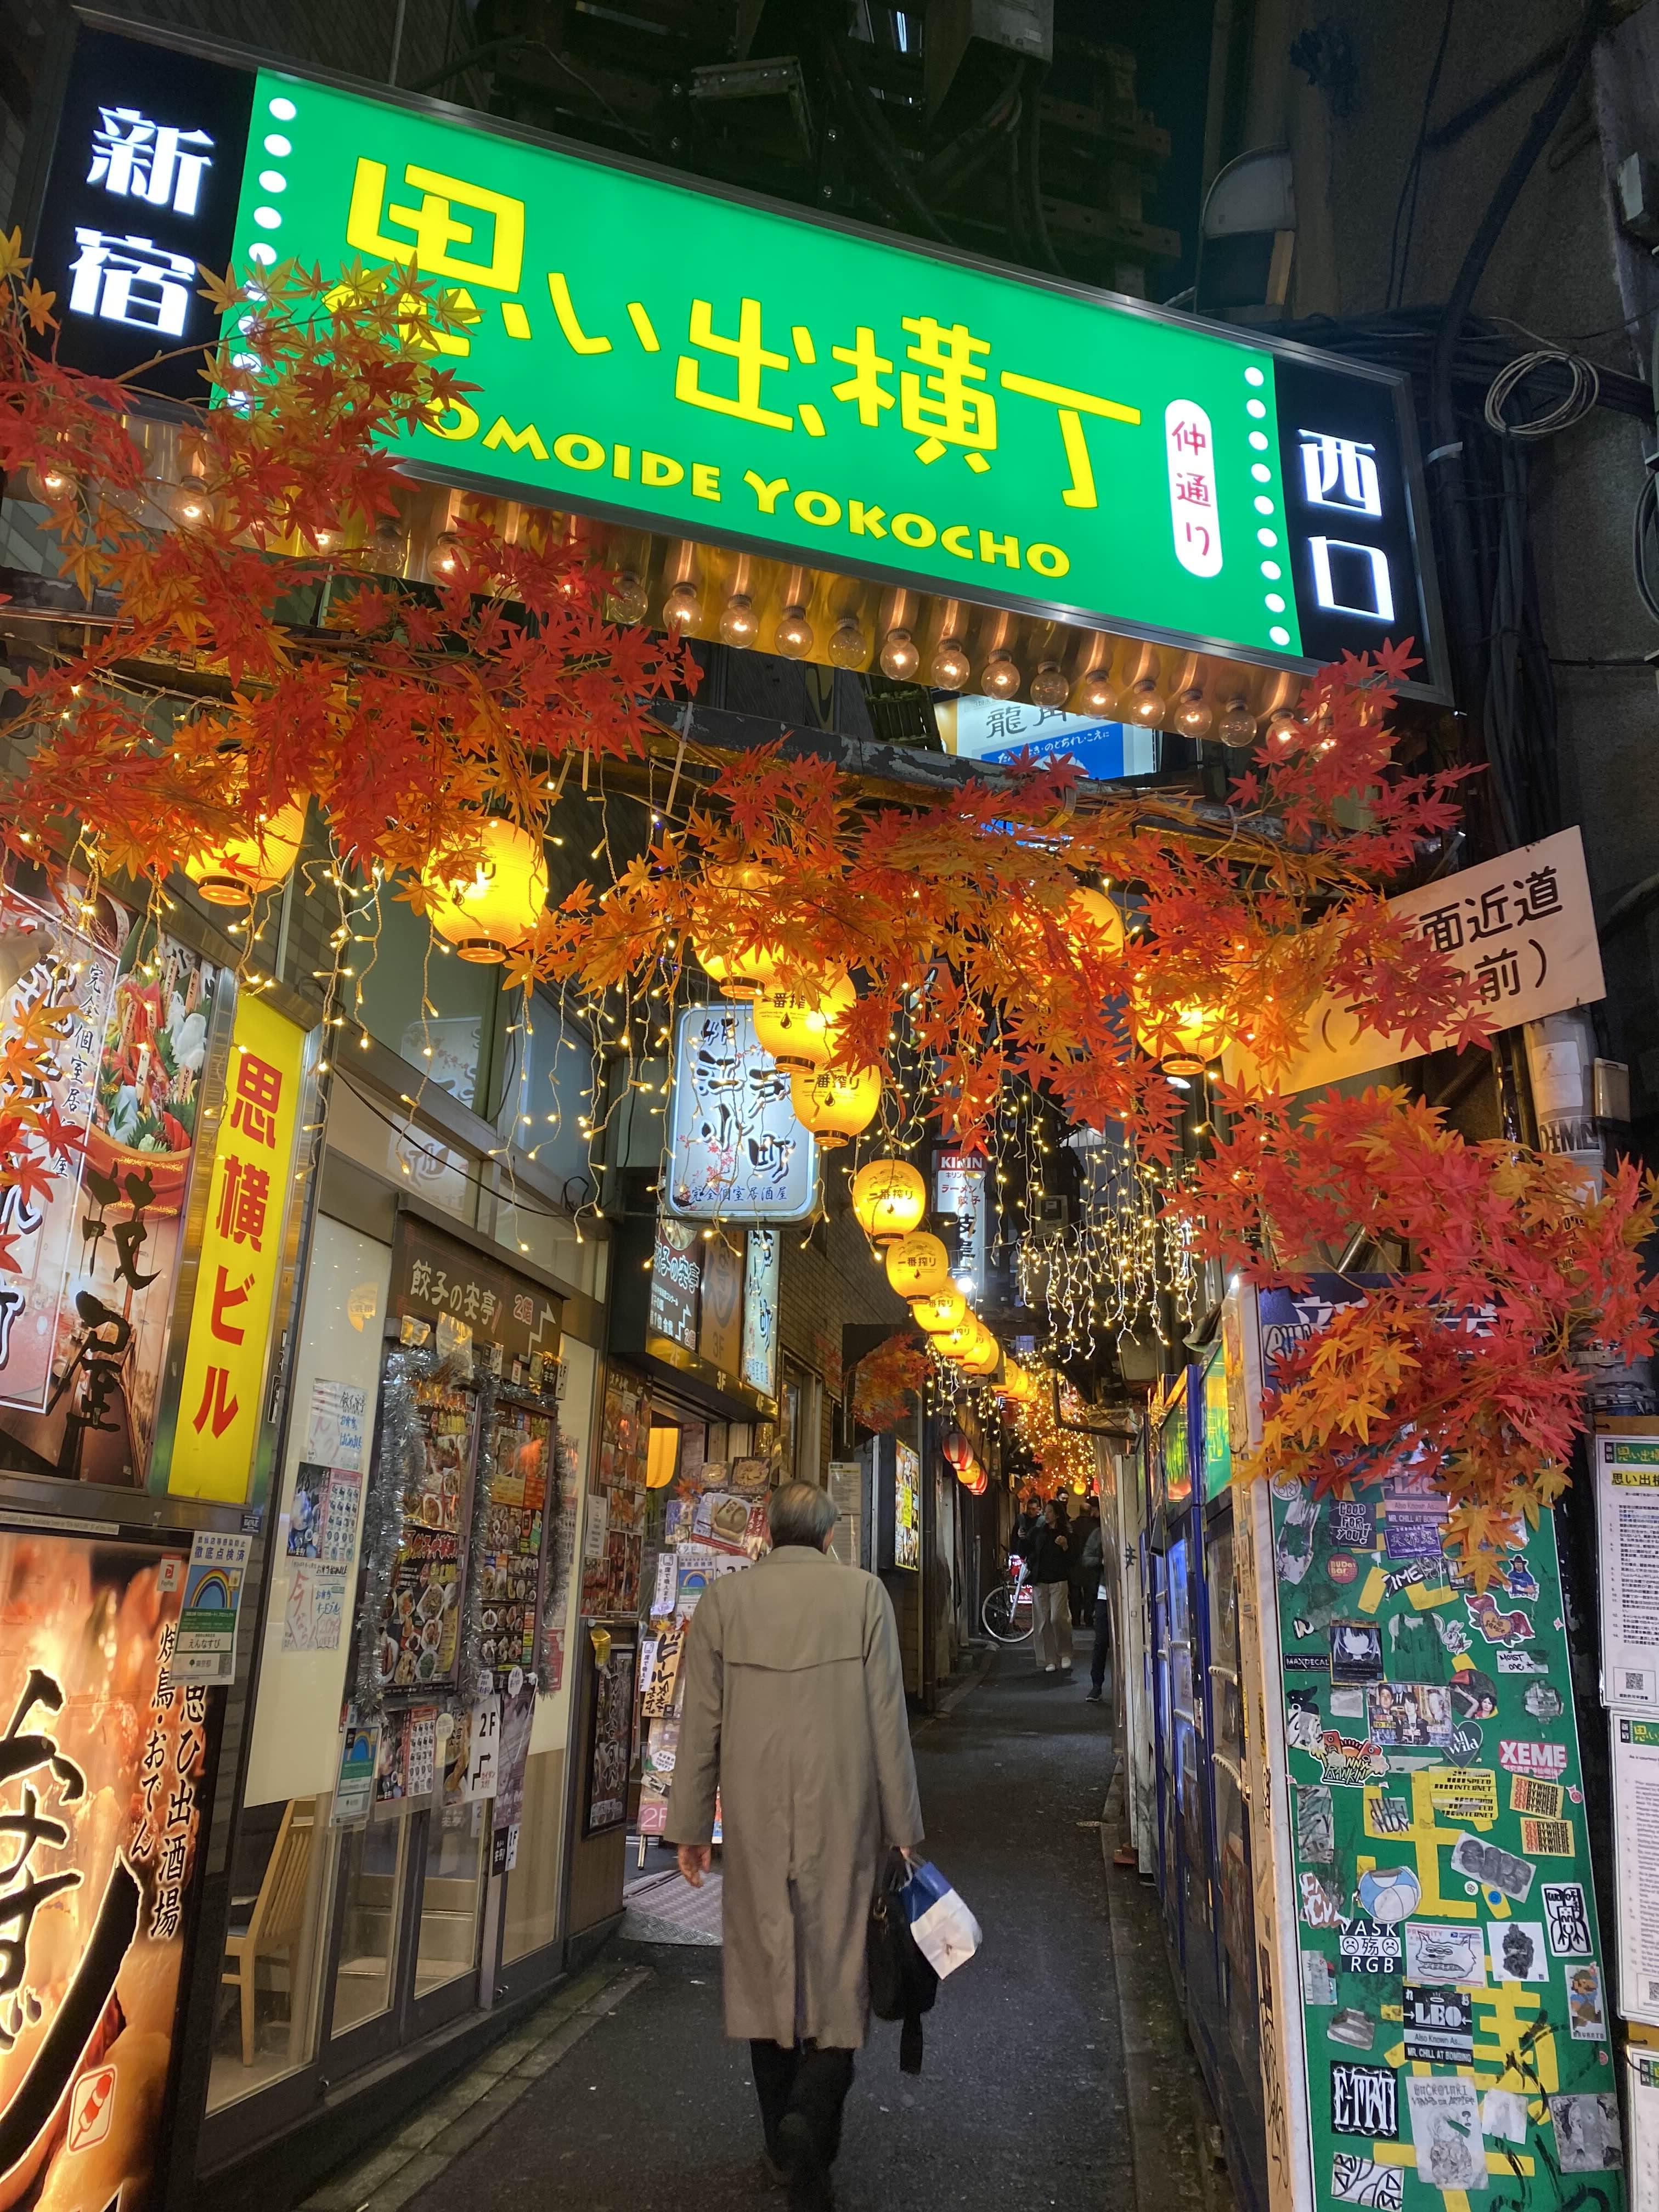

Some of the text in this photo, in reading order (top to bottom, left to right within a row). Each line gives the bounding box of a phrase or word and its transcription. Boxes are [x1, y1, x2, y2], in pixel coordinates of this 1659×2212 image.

[69, 106, 214, 336] 新宿
[321, 156, 1141, 509] 思い出横丁
[421, 396, 1070, 578] OMOIDE YOKOCHO
[1172, 421, 1211, 556] 仲通り
[1297, 428, 1395, 622] 西口
[1419, 866, 1562, 952] 面近道
[53, 963, 104, 1177] 完全個室居屋
[804, 1074, 859, 1090] 一番搾り
[691, 1186, 788, 1203] 完全個室居酒屋
[868, 1188, 913, 1201] 一番搾り
[942, 1184, 977, 1193] ラーメン
[193, 1053, 283, 1439] 思横ビル
[898, 1256, 936, 1267] 一番搾り
[410, 1259, 496, 1325] 餃子の安亭
[514, 1294, 534, 1325] 2階
[929, 1299, 953, 1308] 番搾り
[716, 1370, 727, 1392] 3F
[1339, 1502, 1366, 1516] GOOD
[1341, 1516, 1364, 1530] FOR
[194, 1546, 246, 1562] 徹底点検済
[189, 1638, 221, 1650] えんなすび
[651, 1633, 681, 1683] ビール
[1499, 1654, 1525, 1662] MOIST
[479, 1711, 496, 1737] 2F
[1448, 1737, 1479, 1755] Wild
[1500, 1741, 1567, 1768] XEME
[151, 1684, 207, 1938] 思ひ出酒場
[641, 1807, 668, 1827] 2F
[1351, 1957, 1394, 1973] RGB
[1415, 2033, 1427, 2042] Also
[1429, 2035, 1449, 2044] Known
[1419, 2049, 1435, 2059] CHILL
[1437, 2050, 1444, 2059] AT
